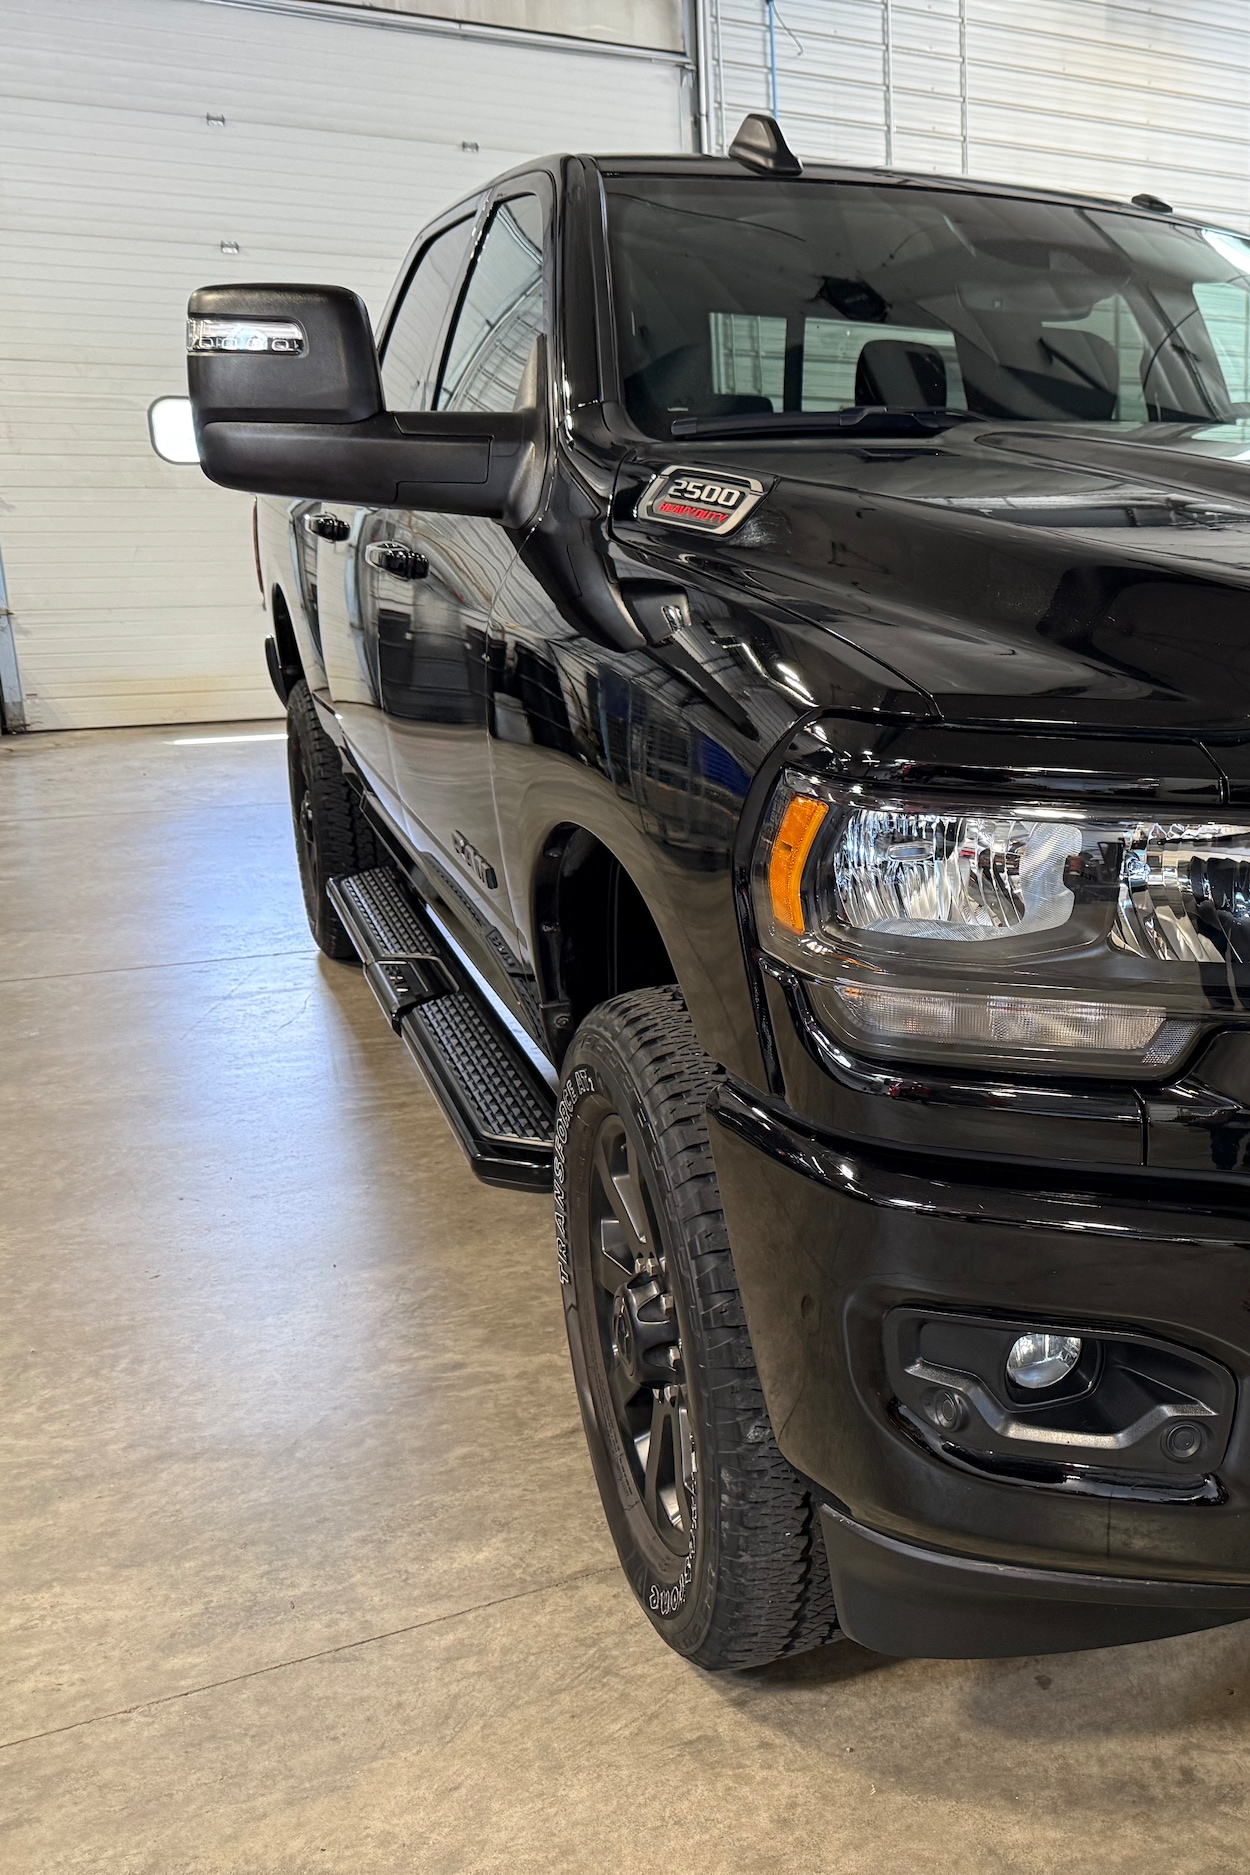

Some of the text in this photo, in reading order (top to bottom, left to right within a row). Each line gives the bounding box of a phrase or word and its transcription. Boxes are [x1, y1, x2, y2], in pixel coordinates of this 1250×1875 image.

[667, 479, 741, 507] 2500
[657, 502, 729, 524] HEAVY DUTY
[553, 1079, 578, 1285] TRANSFORCE
